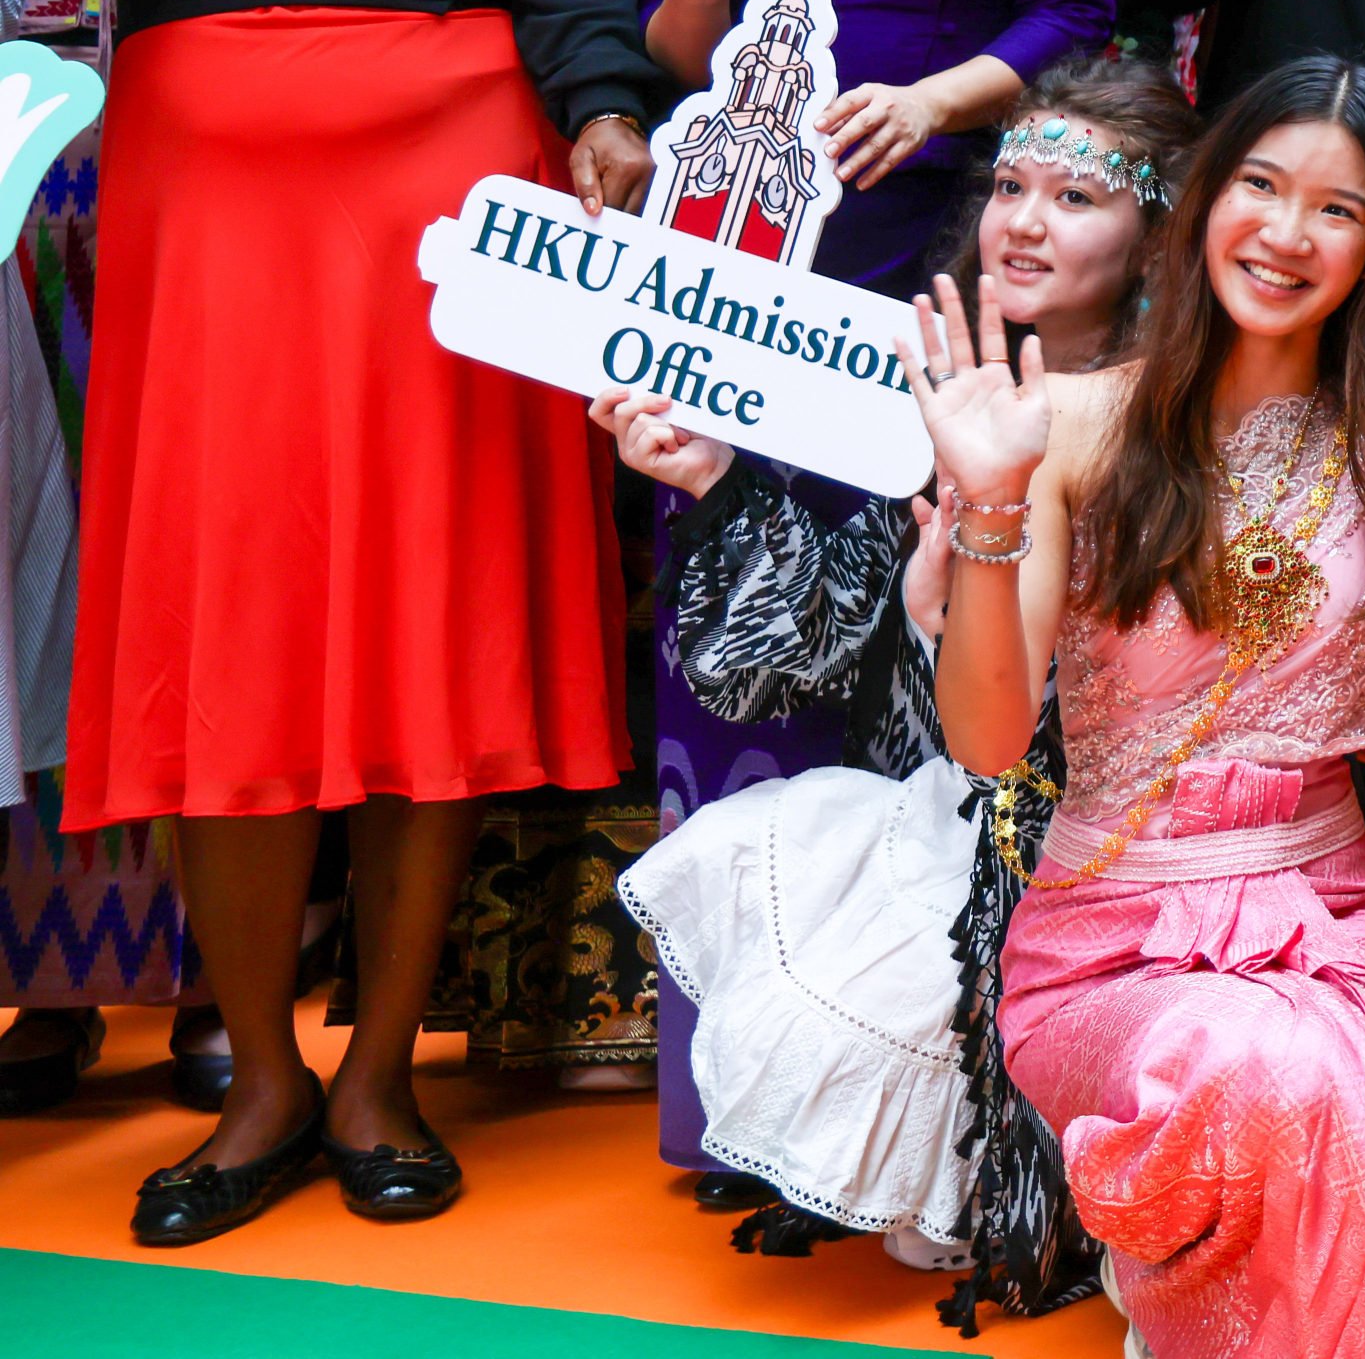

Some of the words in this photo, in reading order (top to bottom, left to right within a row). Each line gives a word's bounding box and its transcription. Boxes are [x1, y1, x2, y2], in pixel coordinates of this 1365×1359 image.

[470, 199, 629, 292] HKU
[625, 254, 937, 398] Admission
[602, 327, 765, 426] Office
